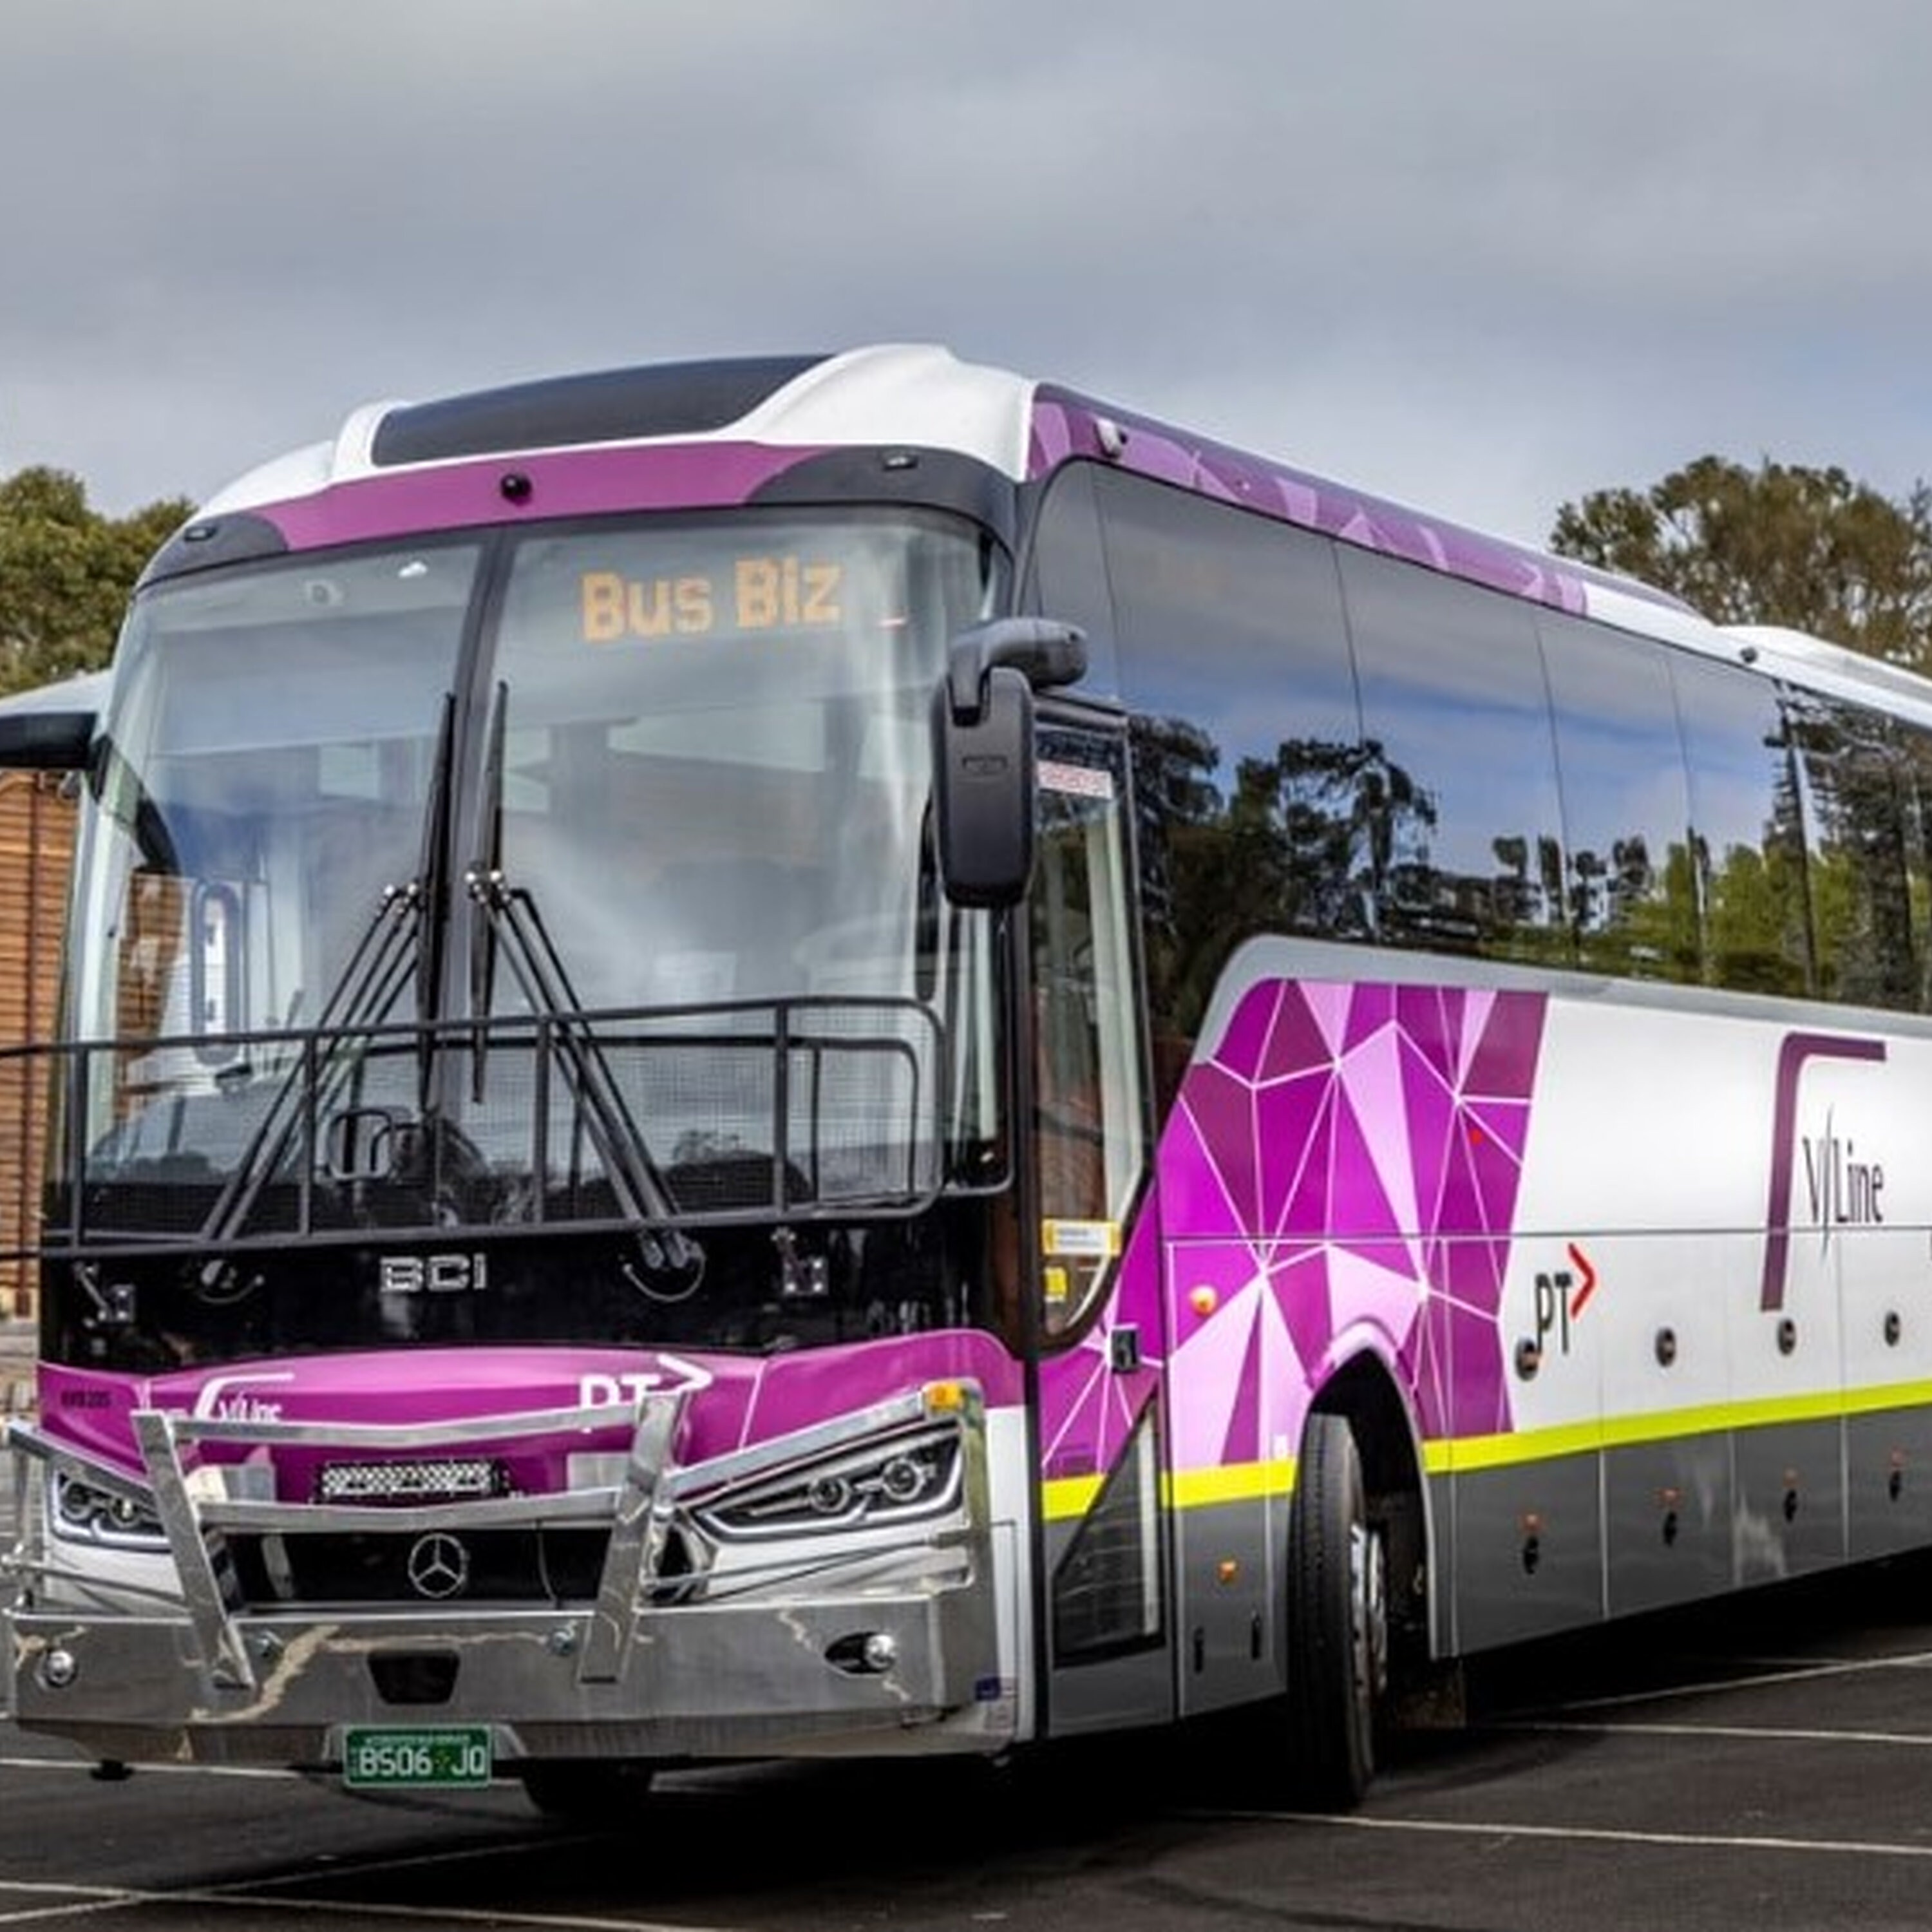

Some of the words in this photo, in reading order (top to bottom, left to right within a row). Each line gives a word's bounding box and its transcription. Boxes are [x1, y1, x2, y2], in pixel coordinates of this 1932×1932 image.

[582, 571, 712, 640] Bus
[735, 556, 841, 626] Biz
[379, 1253, 487, 1292] BCI
